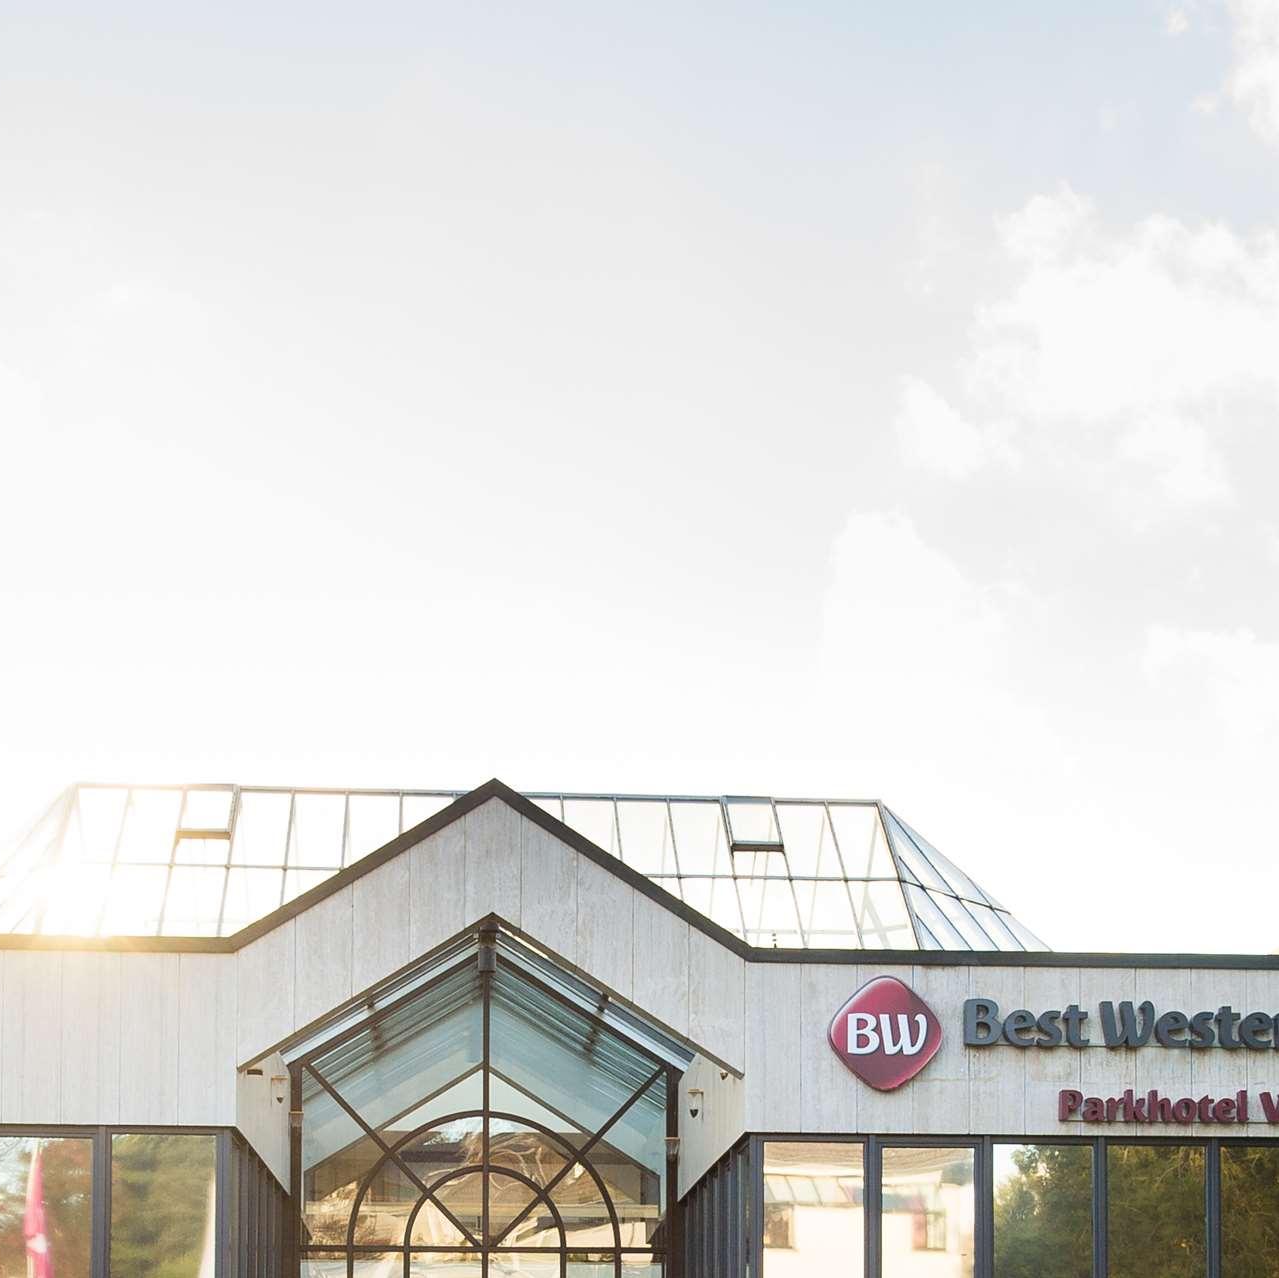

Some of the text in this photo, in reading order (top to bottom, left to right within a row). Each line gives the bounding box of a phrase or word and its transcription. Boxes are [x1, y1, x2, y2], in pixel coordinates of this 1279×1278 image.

[846, 1012, 928, 1057] BW
[963, 997, 1089, 1048] Best
[1057, 1089, 1248, 1124] Parkhotel
